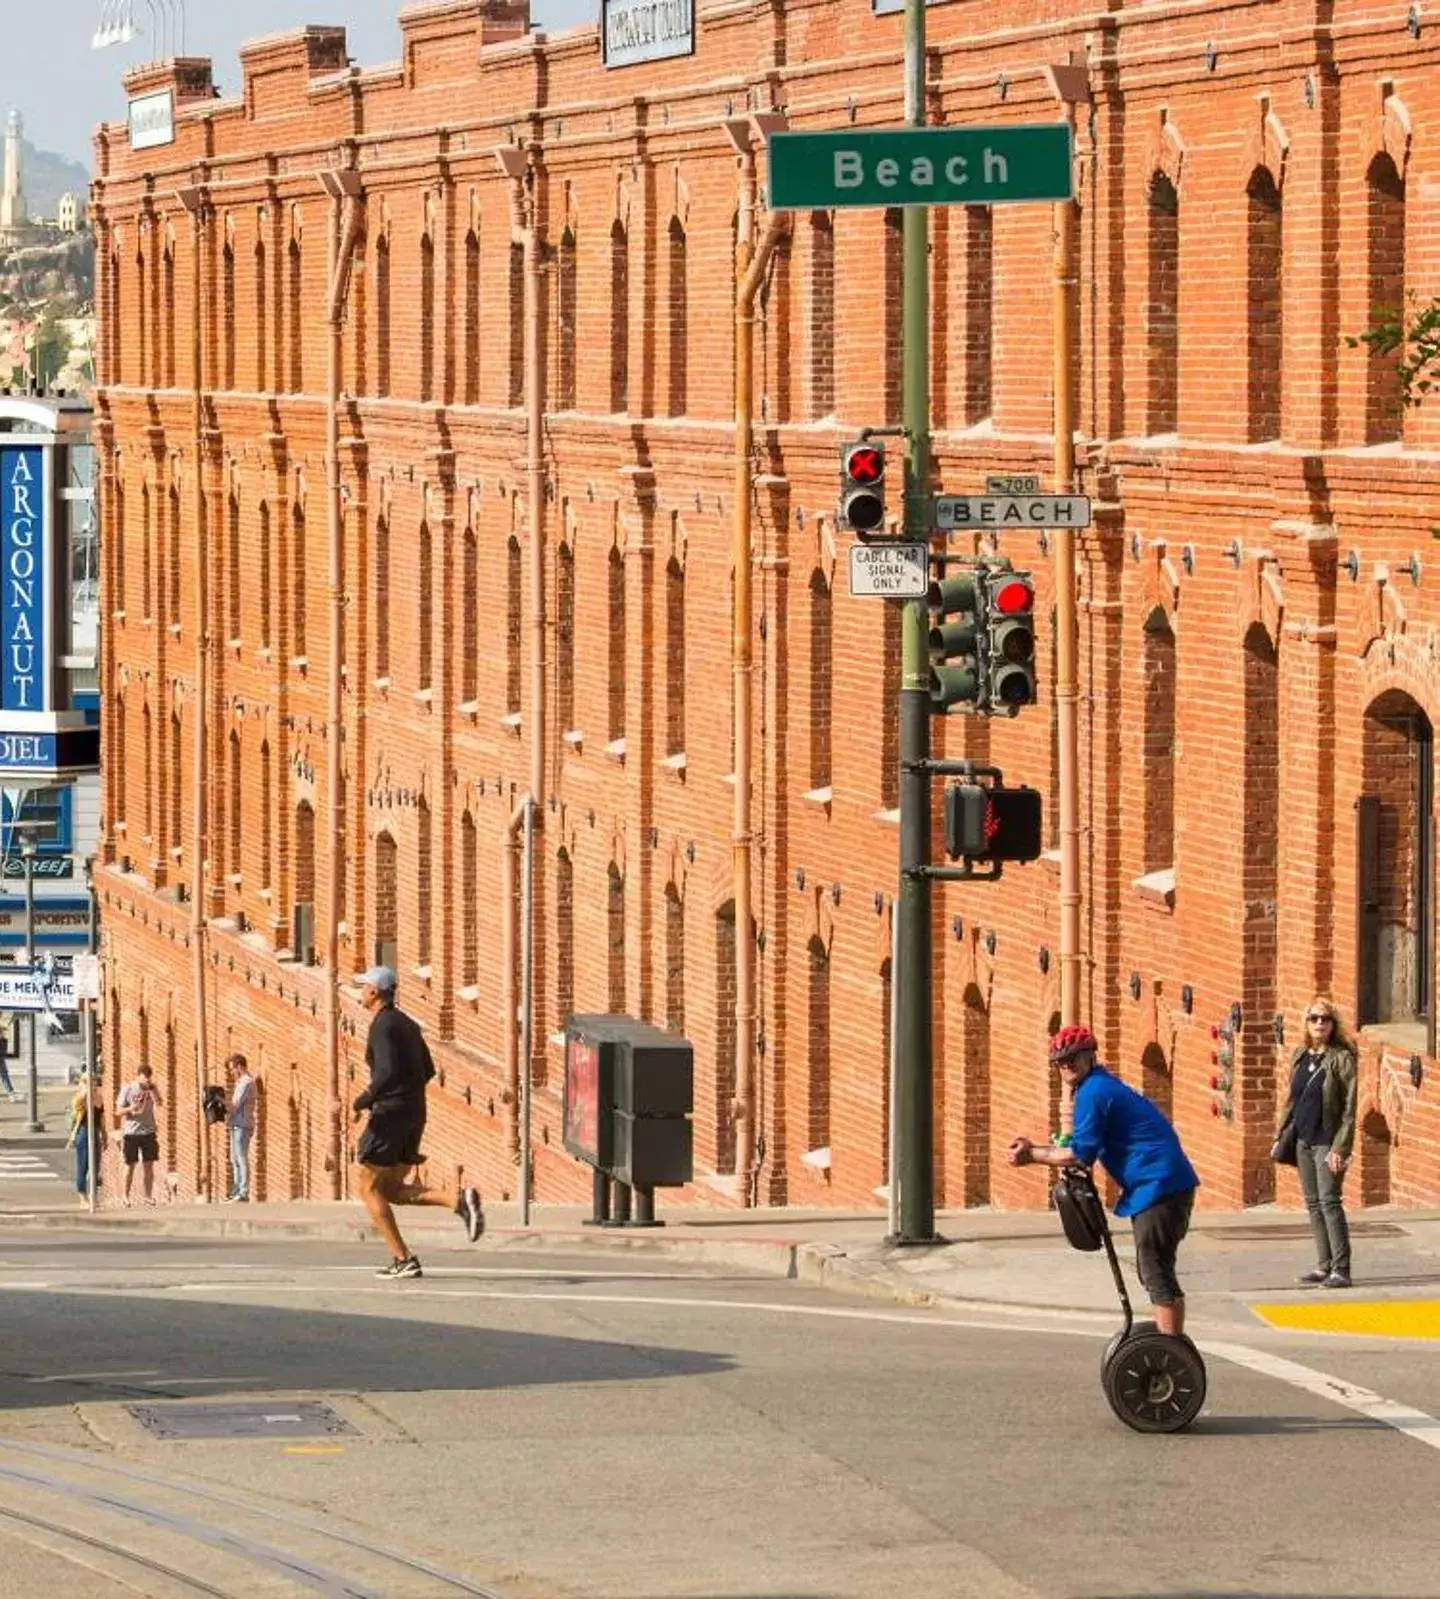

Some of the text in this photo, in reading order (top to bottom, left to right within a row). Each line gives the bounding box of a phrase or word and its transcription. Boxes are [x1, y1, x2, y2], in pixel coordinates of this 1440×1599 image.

[833, 148, 1009, 188] Beach
[1005, 478, 1035, 493] 700
[953, 501, 1073, 522] BEACH
[856, 548, 919, 563] CABLE CAR
[867, 564, 906, 577] SIGNAL
[10, 451, 38, 708] ARGONAUT
[872, 577, 901, 589] ONLY
